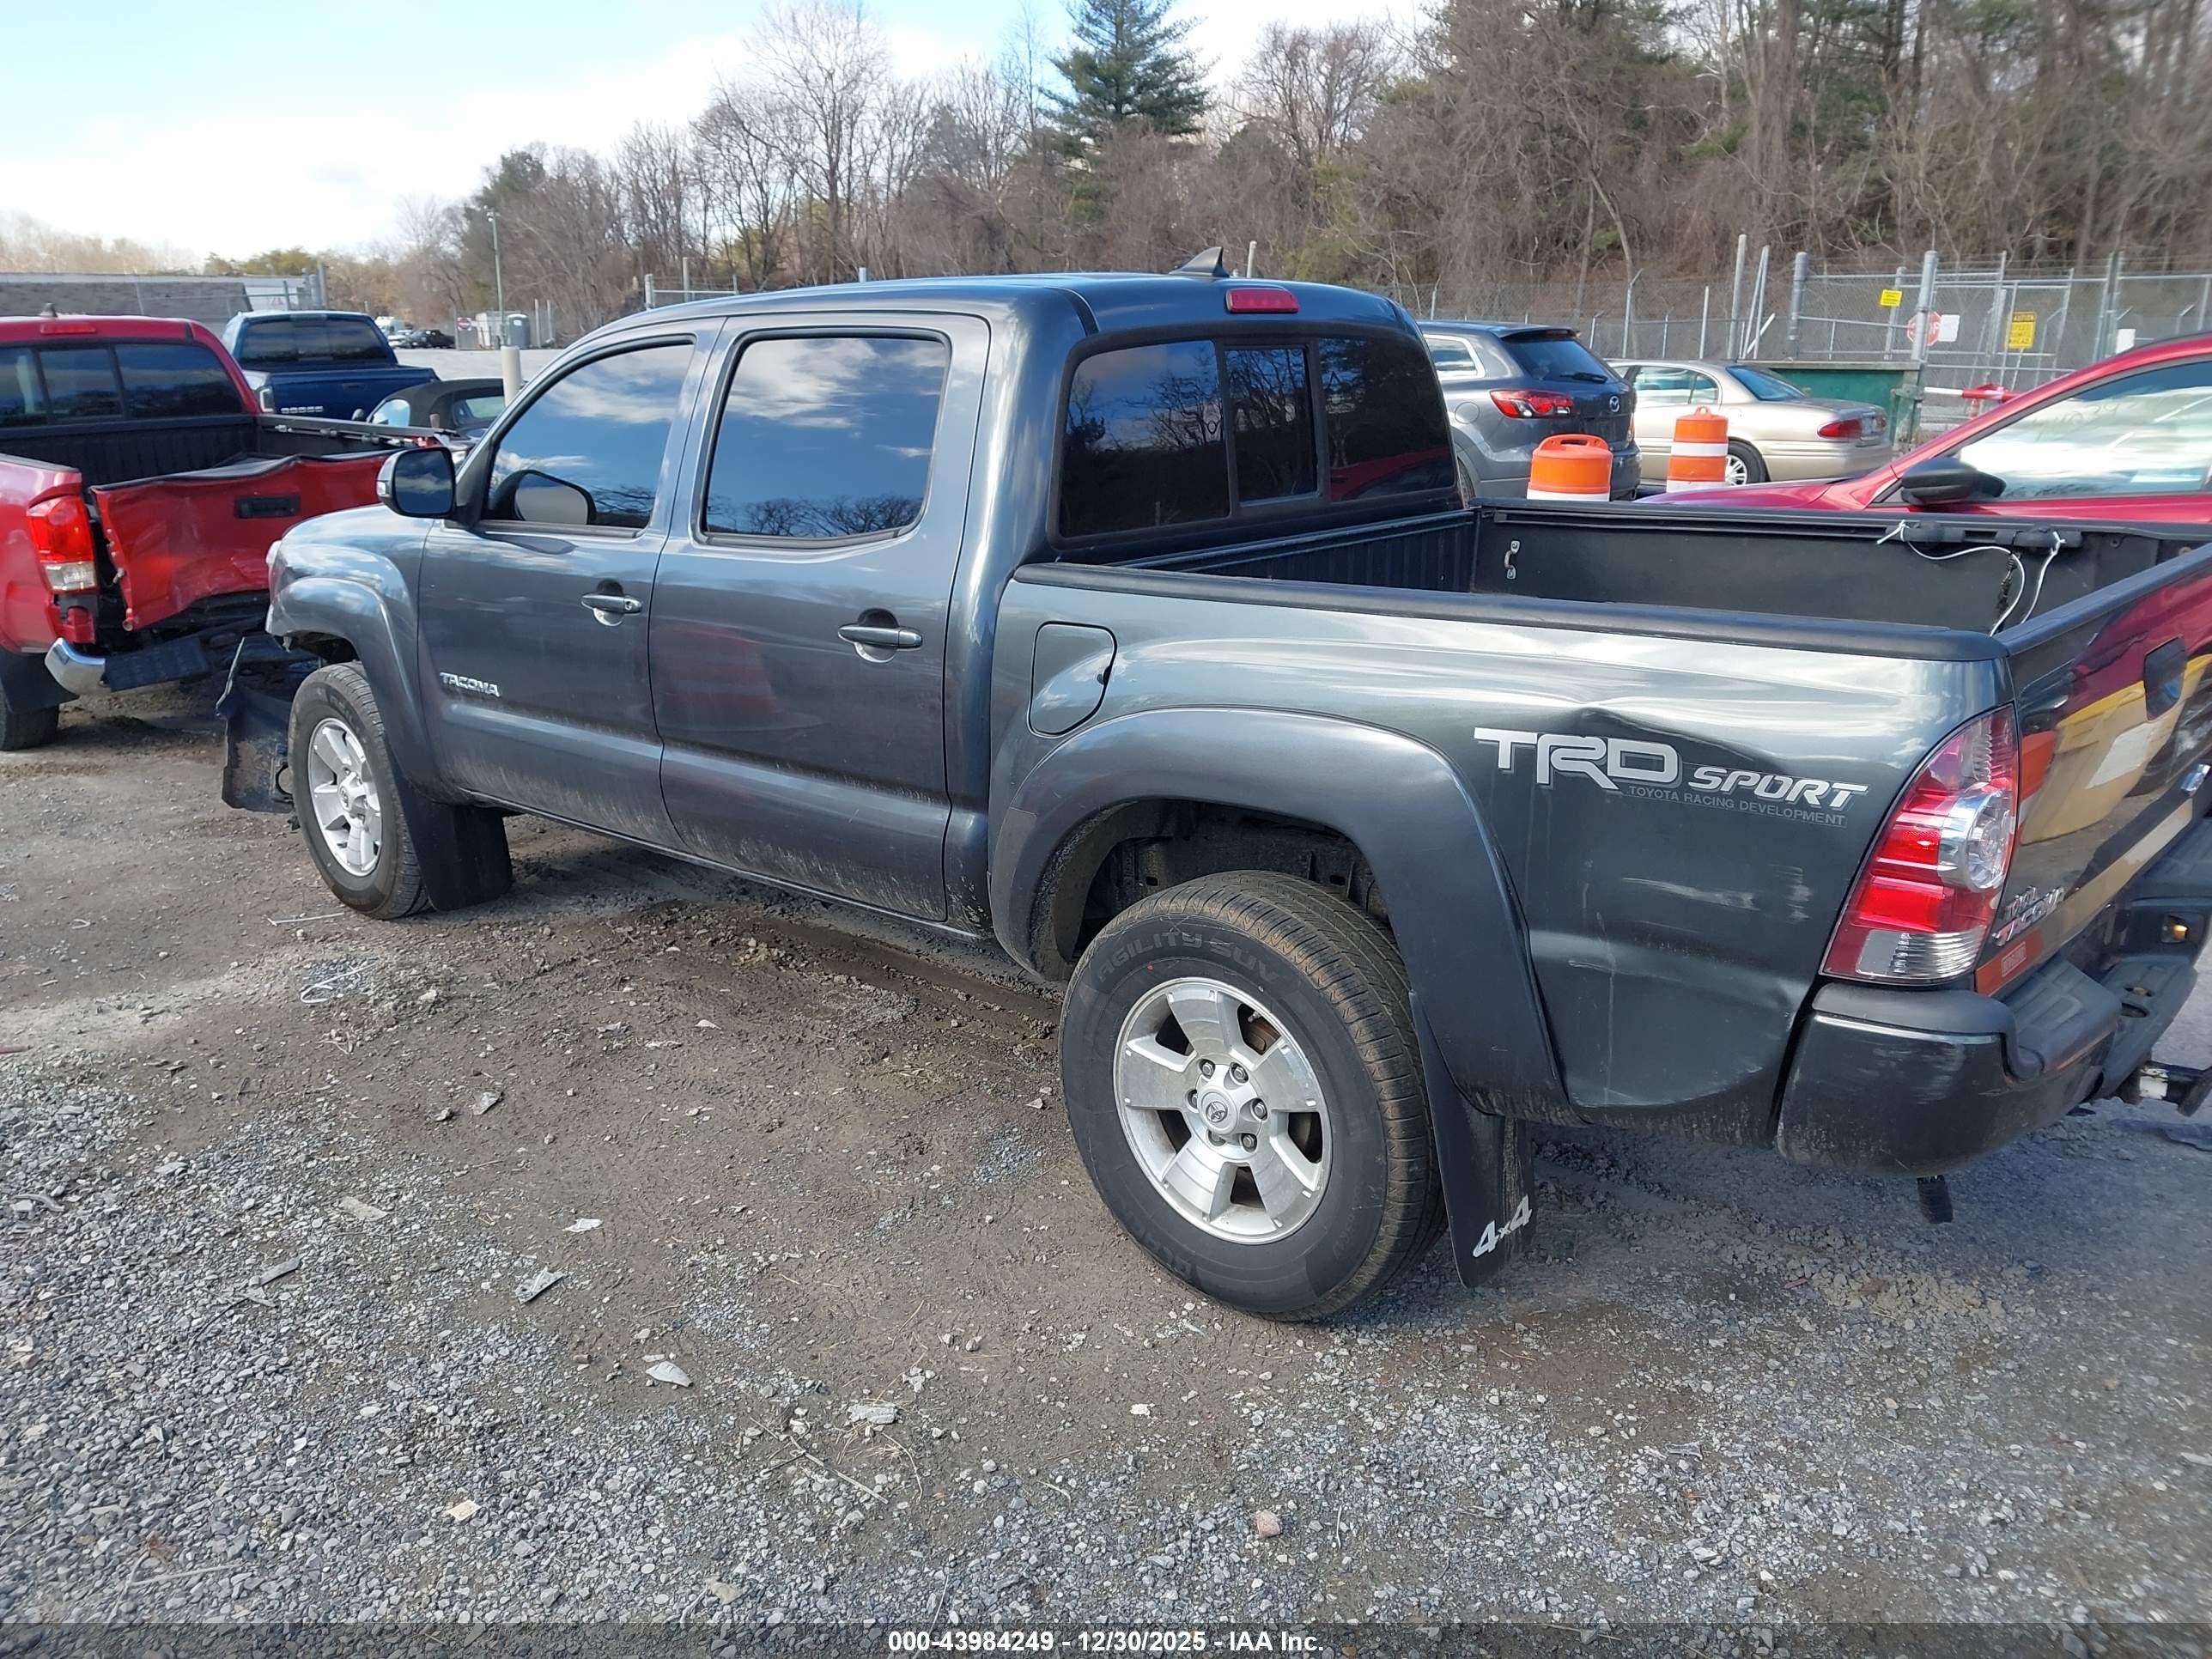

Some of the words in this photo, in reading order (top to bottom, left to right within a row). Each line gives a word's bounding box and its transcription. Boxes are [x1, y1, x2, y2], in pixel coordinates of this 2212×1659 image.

[440, 672, 501, 697] TACOMA
[1474, 727, 1681, 792] TRD
[1688, 766, 1869, 810] SPORT
[1628, 785, 1680, 803] TOYOTA
[1684, 793, 1735, 810] RACING
[1740, 800, 1845, 826] DEVELOPMENT
[1097, 932, 1202, 983] AGILITY
[1208, 936, 1279, 983] SUV
